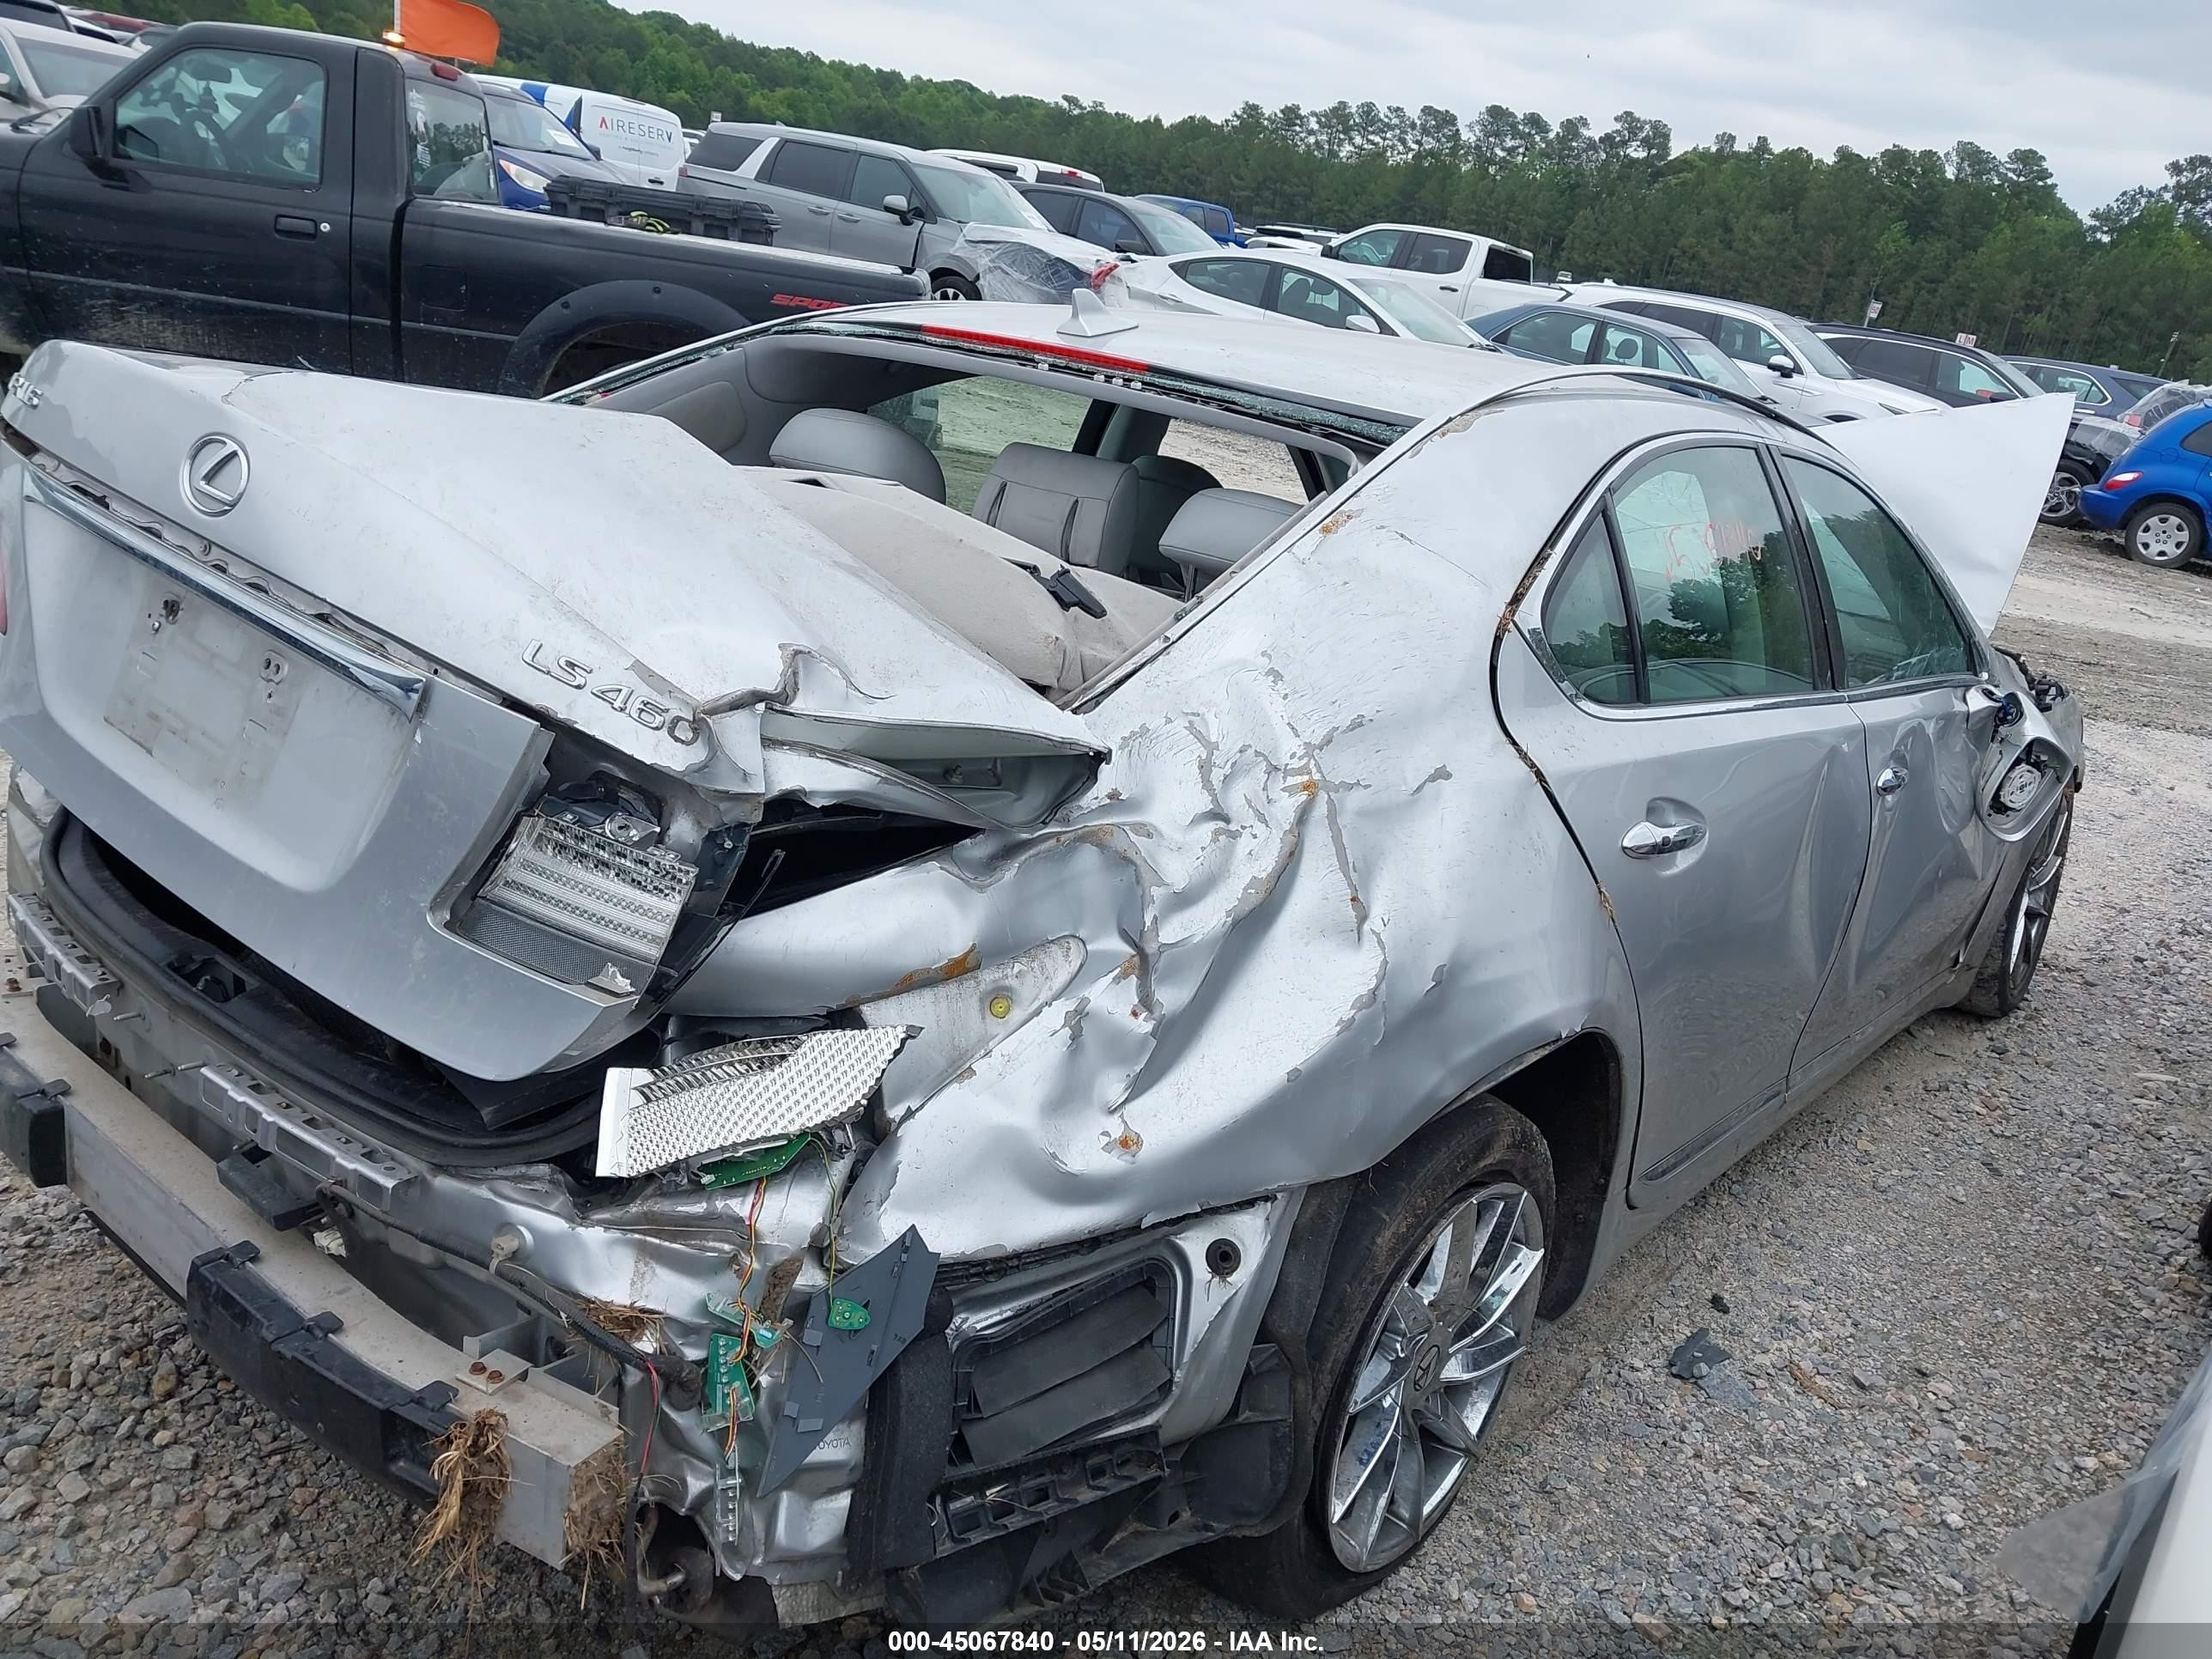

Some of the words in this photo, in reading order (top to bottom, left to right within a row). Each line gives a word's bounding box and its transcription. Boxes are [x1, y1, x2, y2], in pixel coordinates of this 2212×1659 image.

[599, 116, 673, 143] AIRESERV
[521, 638, 593, 690] LS
[590, 684, 701, 746] 460
[817, 1436, 853, 1450] OYOTA
